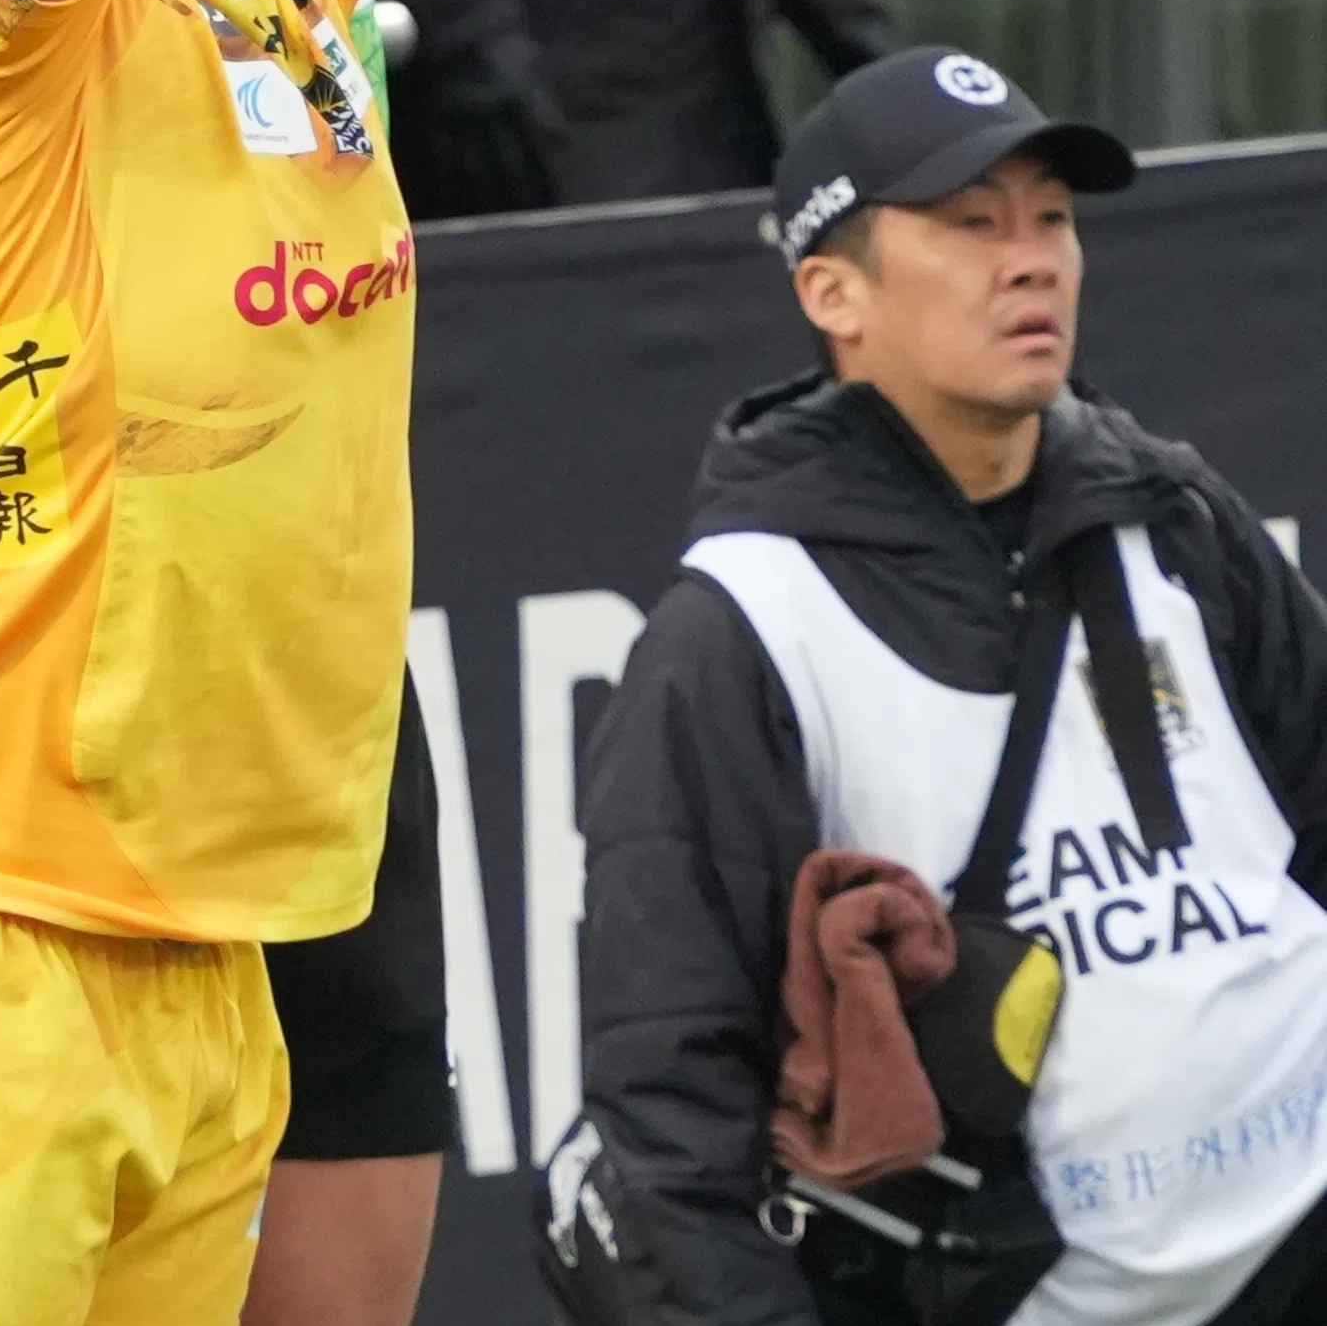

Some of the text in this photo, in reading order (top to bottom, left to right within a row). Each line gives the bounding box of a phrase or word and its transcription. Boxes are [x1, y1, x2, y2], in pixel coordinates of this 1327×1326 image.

[292, 242, 324, 262] NTT
[1007, 823, 1185, 917] EAM
[1026, 881, 1268, 975] ICAL
